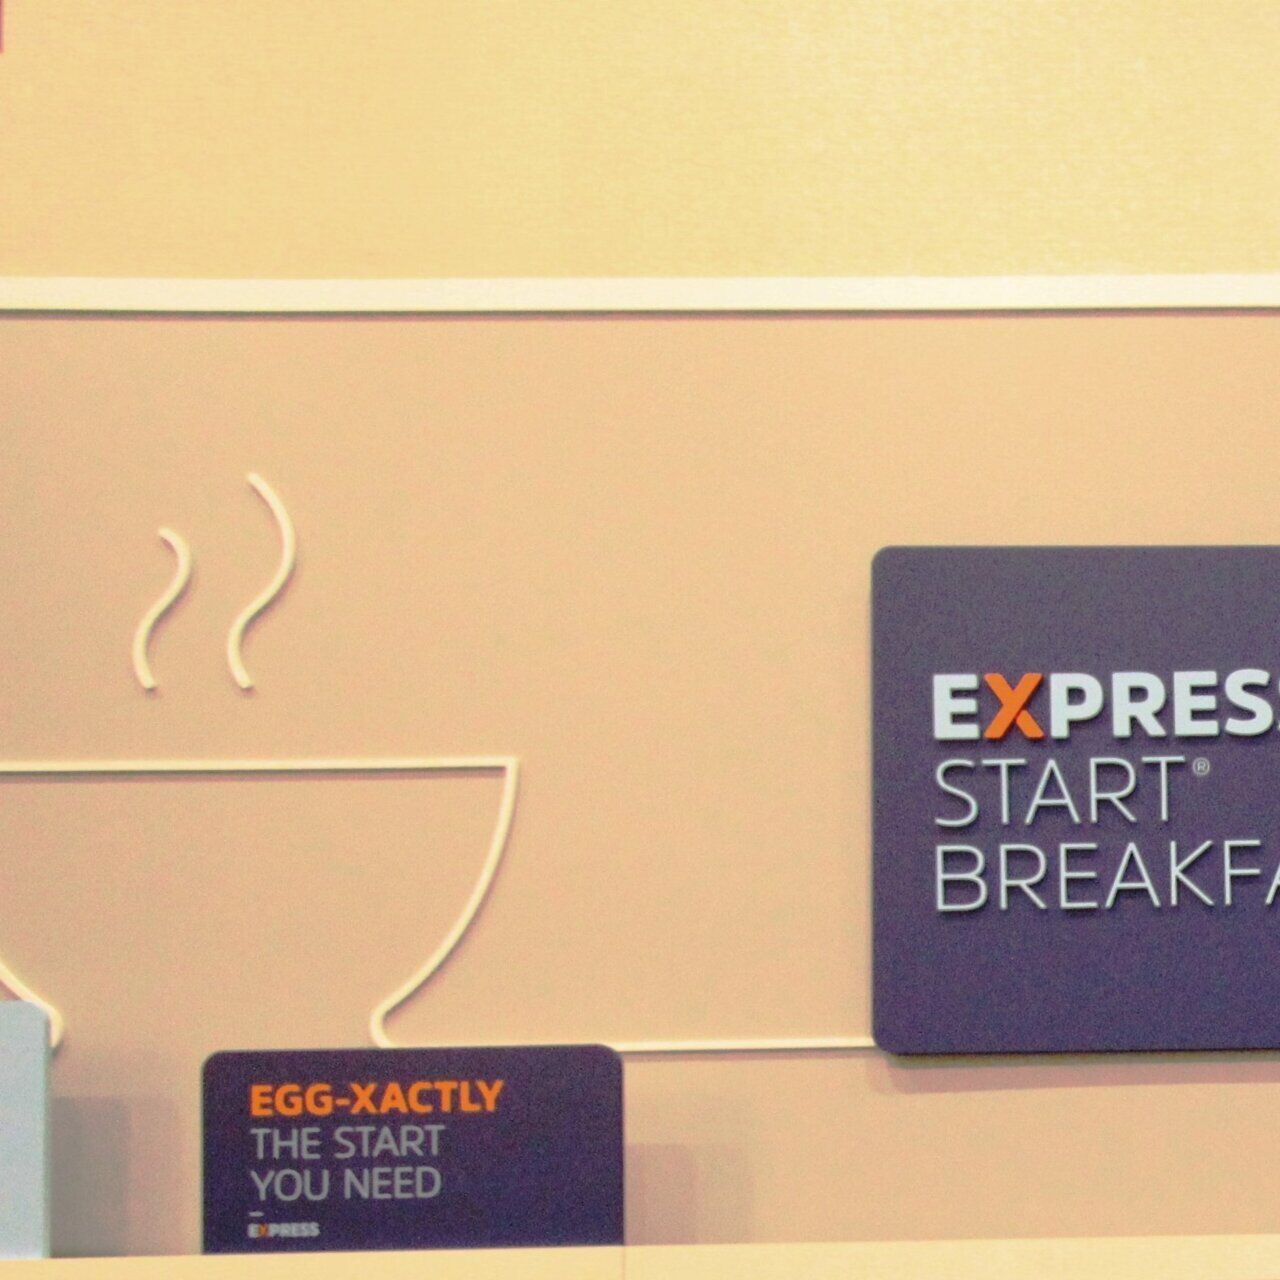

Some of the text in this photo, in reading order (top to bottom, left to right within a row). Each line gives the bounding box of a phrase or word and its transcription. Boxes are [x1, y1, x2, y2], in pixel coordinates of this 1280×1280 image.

[250, 1080, 504, 1116] EGG-XACTLY
[250, 1125, 446, 1160] THE START
[250, 1166, 442, 1201] YOU NEED
[248, 1222, 321, 1238] EXPRESS
